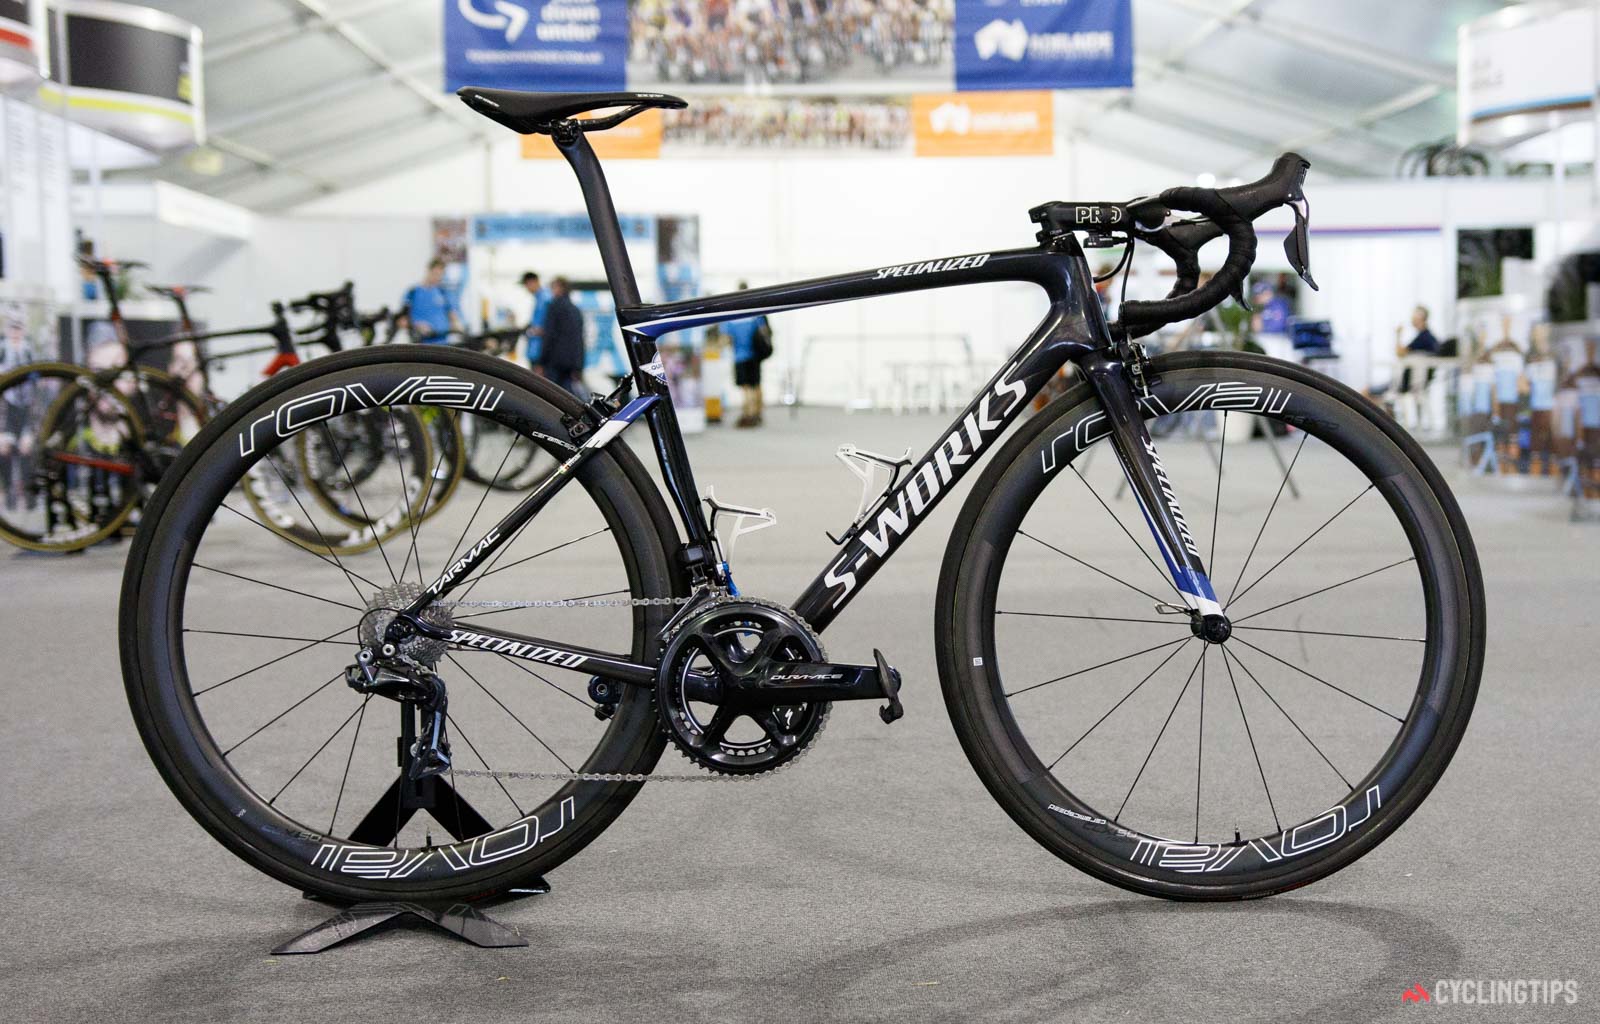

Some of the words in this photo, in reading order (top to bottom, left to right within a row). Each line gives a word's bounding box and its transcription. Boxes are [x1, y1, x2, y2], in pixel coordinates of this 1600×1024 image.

[872, 254, 990, 280] SPECIALIZED
[824, 361, 1027, 609] S-WORKS
[426, 527, 501, 594] TARMAC
[443, 629, 588, 668] SPECIALIZED
[770, 673, 844, 681] DURA-ACE
